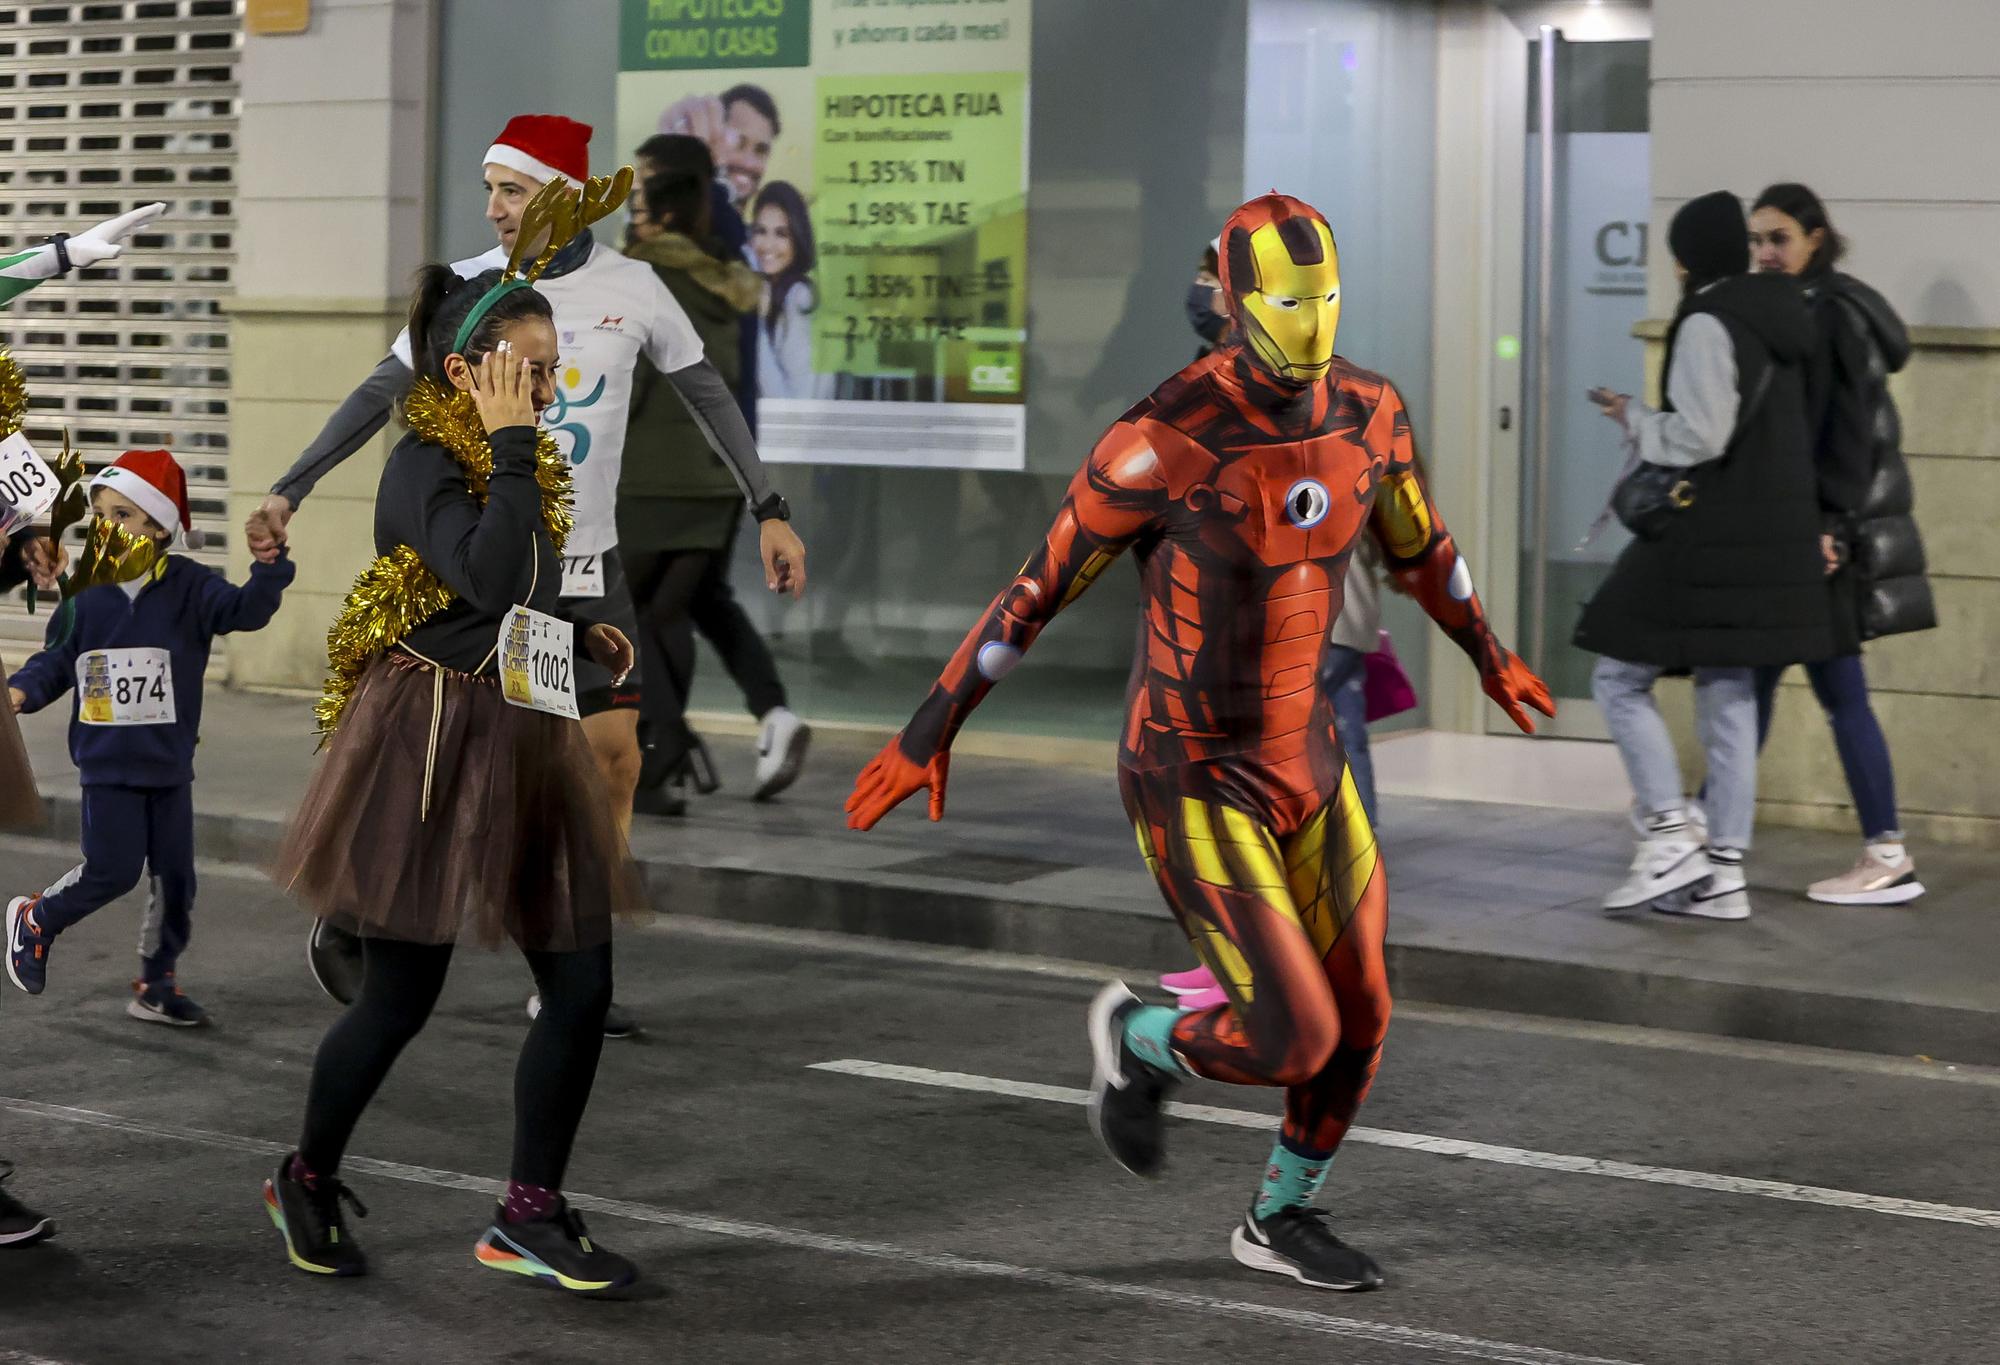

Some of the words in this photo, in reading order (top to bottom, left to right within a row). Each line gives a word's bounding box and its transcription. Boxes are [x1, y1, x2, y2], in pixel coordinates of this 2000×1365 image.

[645, 28, 709, 58] COMO
[714, 26, 777, 56] CASAS
[849, 23, 908, 42] ahorra
[914, 21, 956, 41] cada
[825, 93, 946, 118] HIPOTECA
[848, 160, 918, 187] 1,35%
[925, 160, 965, 183] TIN
[848, 202, 917, 228] 1,98%
[924, 202, 970, 224] TAE
[532, 649, 570, 693] 1002
[116, 675, 166, 704] 874
